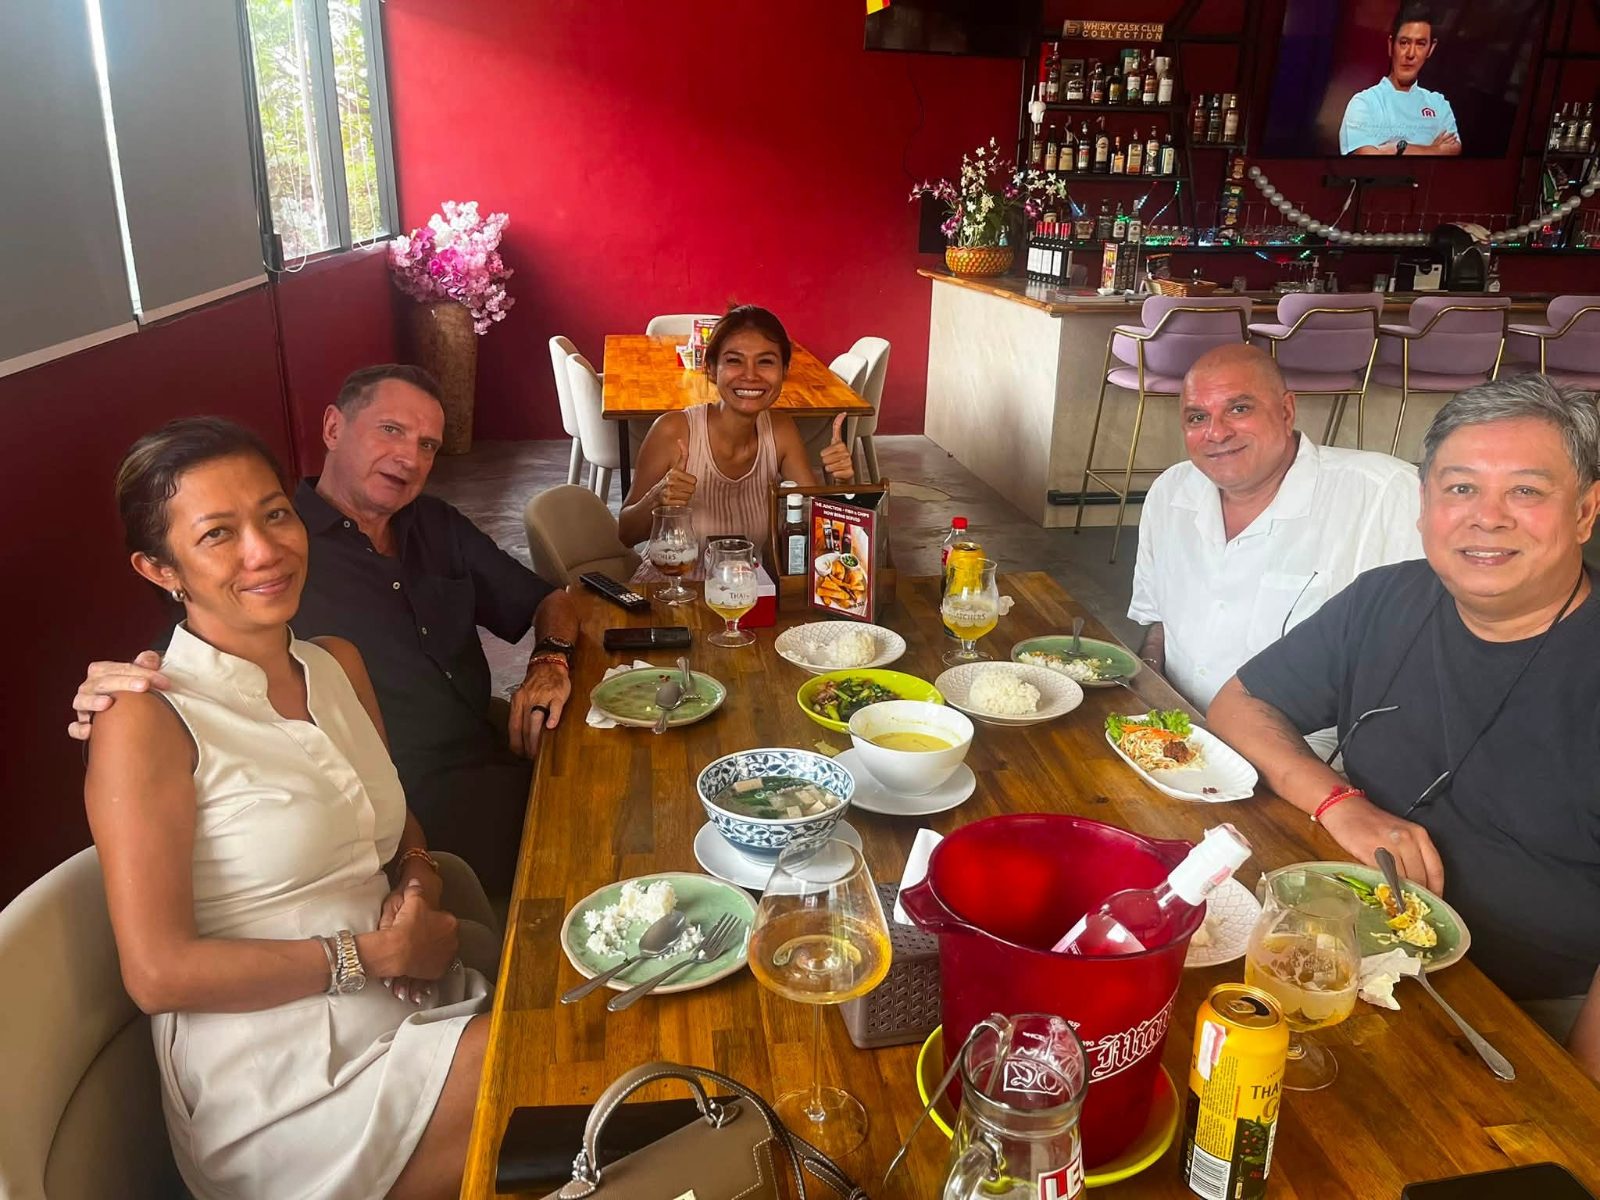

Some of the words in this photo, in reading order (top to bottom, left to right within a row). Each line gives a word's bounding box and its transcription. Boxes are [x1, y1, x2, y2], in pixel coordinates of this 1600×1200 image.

[1083, 21, 1116, 31] WHISKY
[1117, 23, 1140, 32] CASK
[1141, 24, 1163, 33] CLUB
[1082, 30, 1163, 40] COLLECTION
[1045, 1157, 1084, 1200] LE
